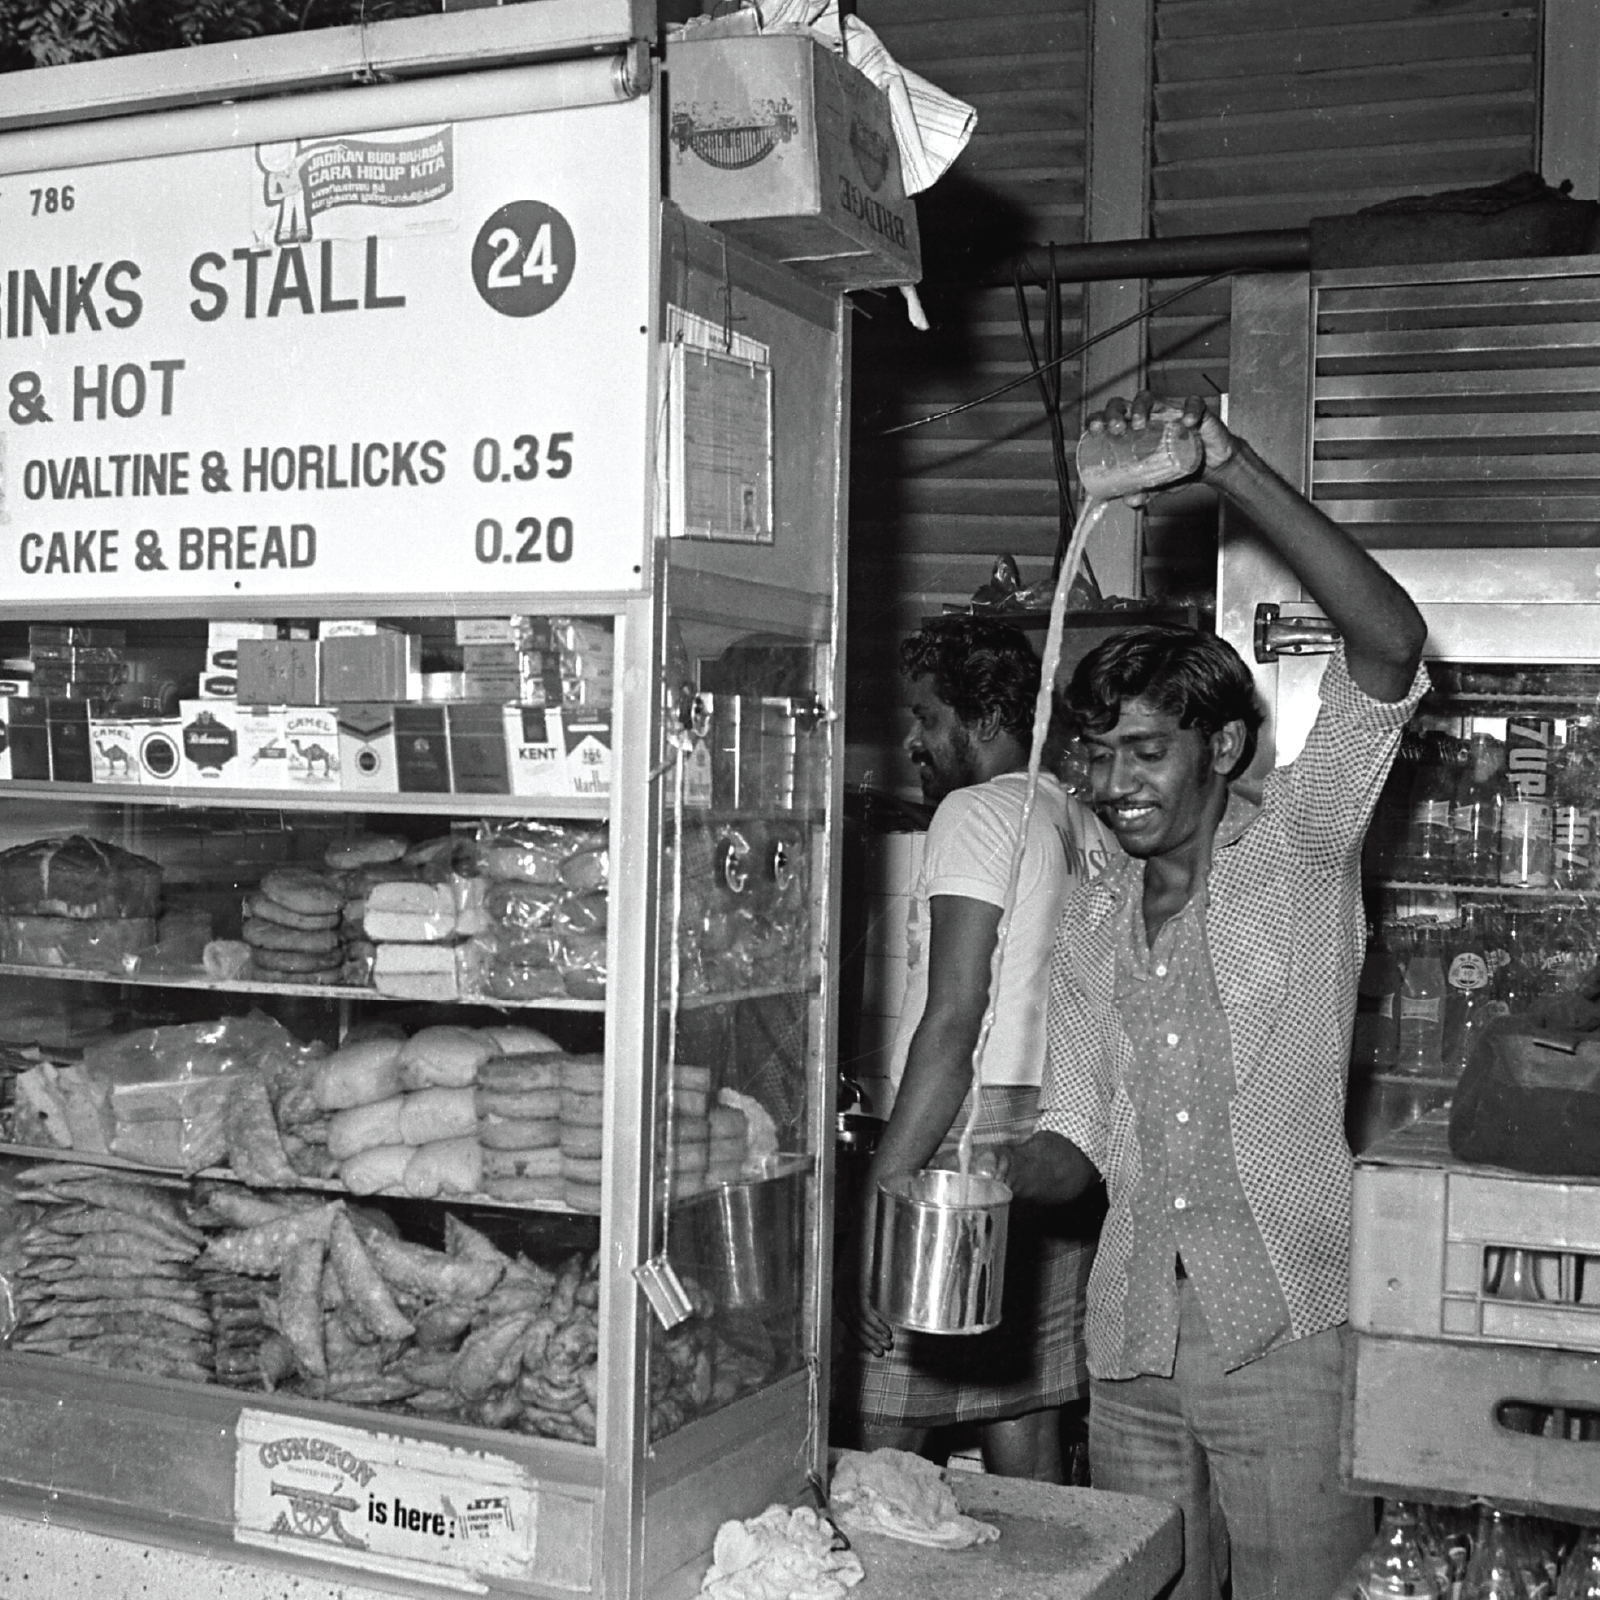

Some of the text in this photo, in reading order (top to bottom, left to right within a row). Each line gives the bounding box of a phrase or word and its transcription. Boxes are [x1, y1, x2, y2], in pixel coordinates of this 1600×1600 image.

[307, 156, 446, 187] CARA HIDUP KITA
[308, 150, 365, 172] JADIKAN
[29, 184, 76, 217] 786
[486, 223, 559, 291] 24
[0, 235, 407, 339] INKS STALL
[8, 359, 186, 426] & HOT
[23, 432, 575, 501] OVALTINE & HORLICKS 0.35
[19, 516, 575, 574] CAKE & BREAD 0.20
[93, 728, 131, 740] CAMEL
[287, 717, 331, 731] CAMEL
[518, 747, 558, 761] KENT
[1505, 721, 1549, 796] 7UP
[1552, 804, 1591, 870] 7UP
[258, 1437, 378, 1488] GUNSTON
[368, 1493, 388, 1526] is
